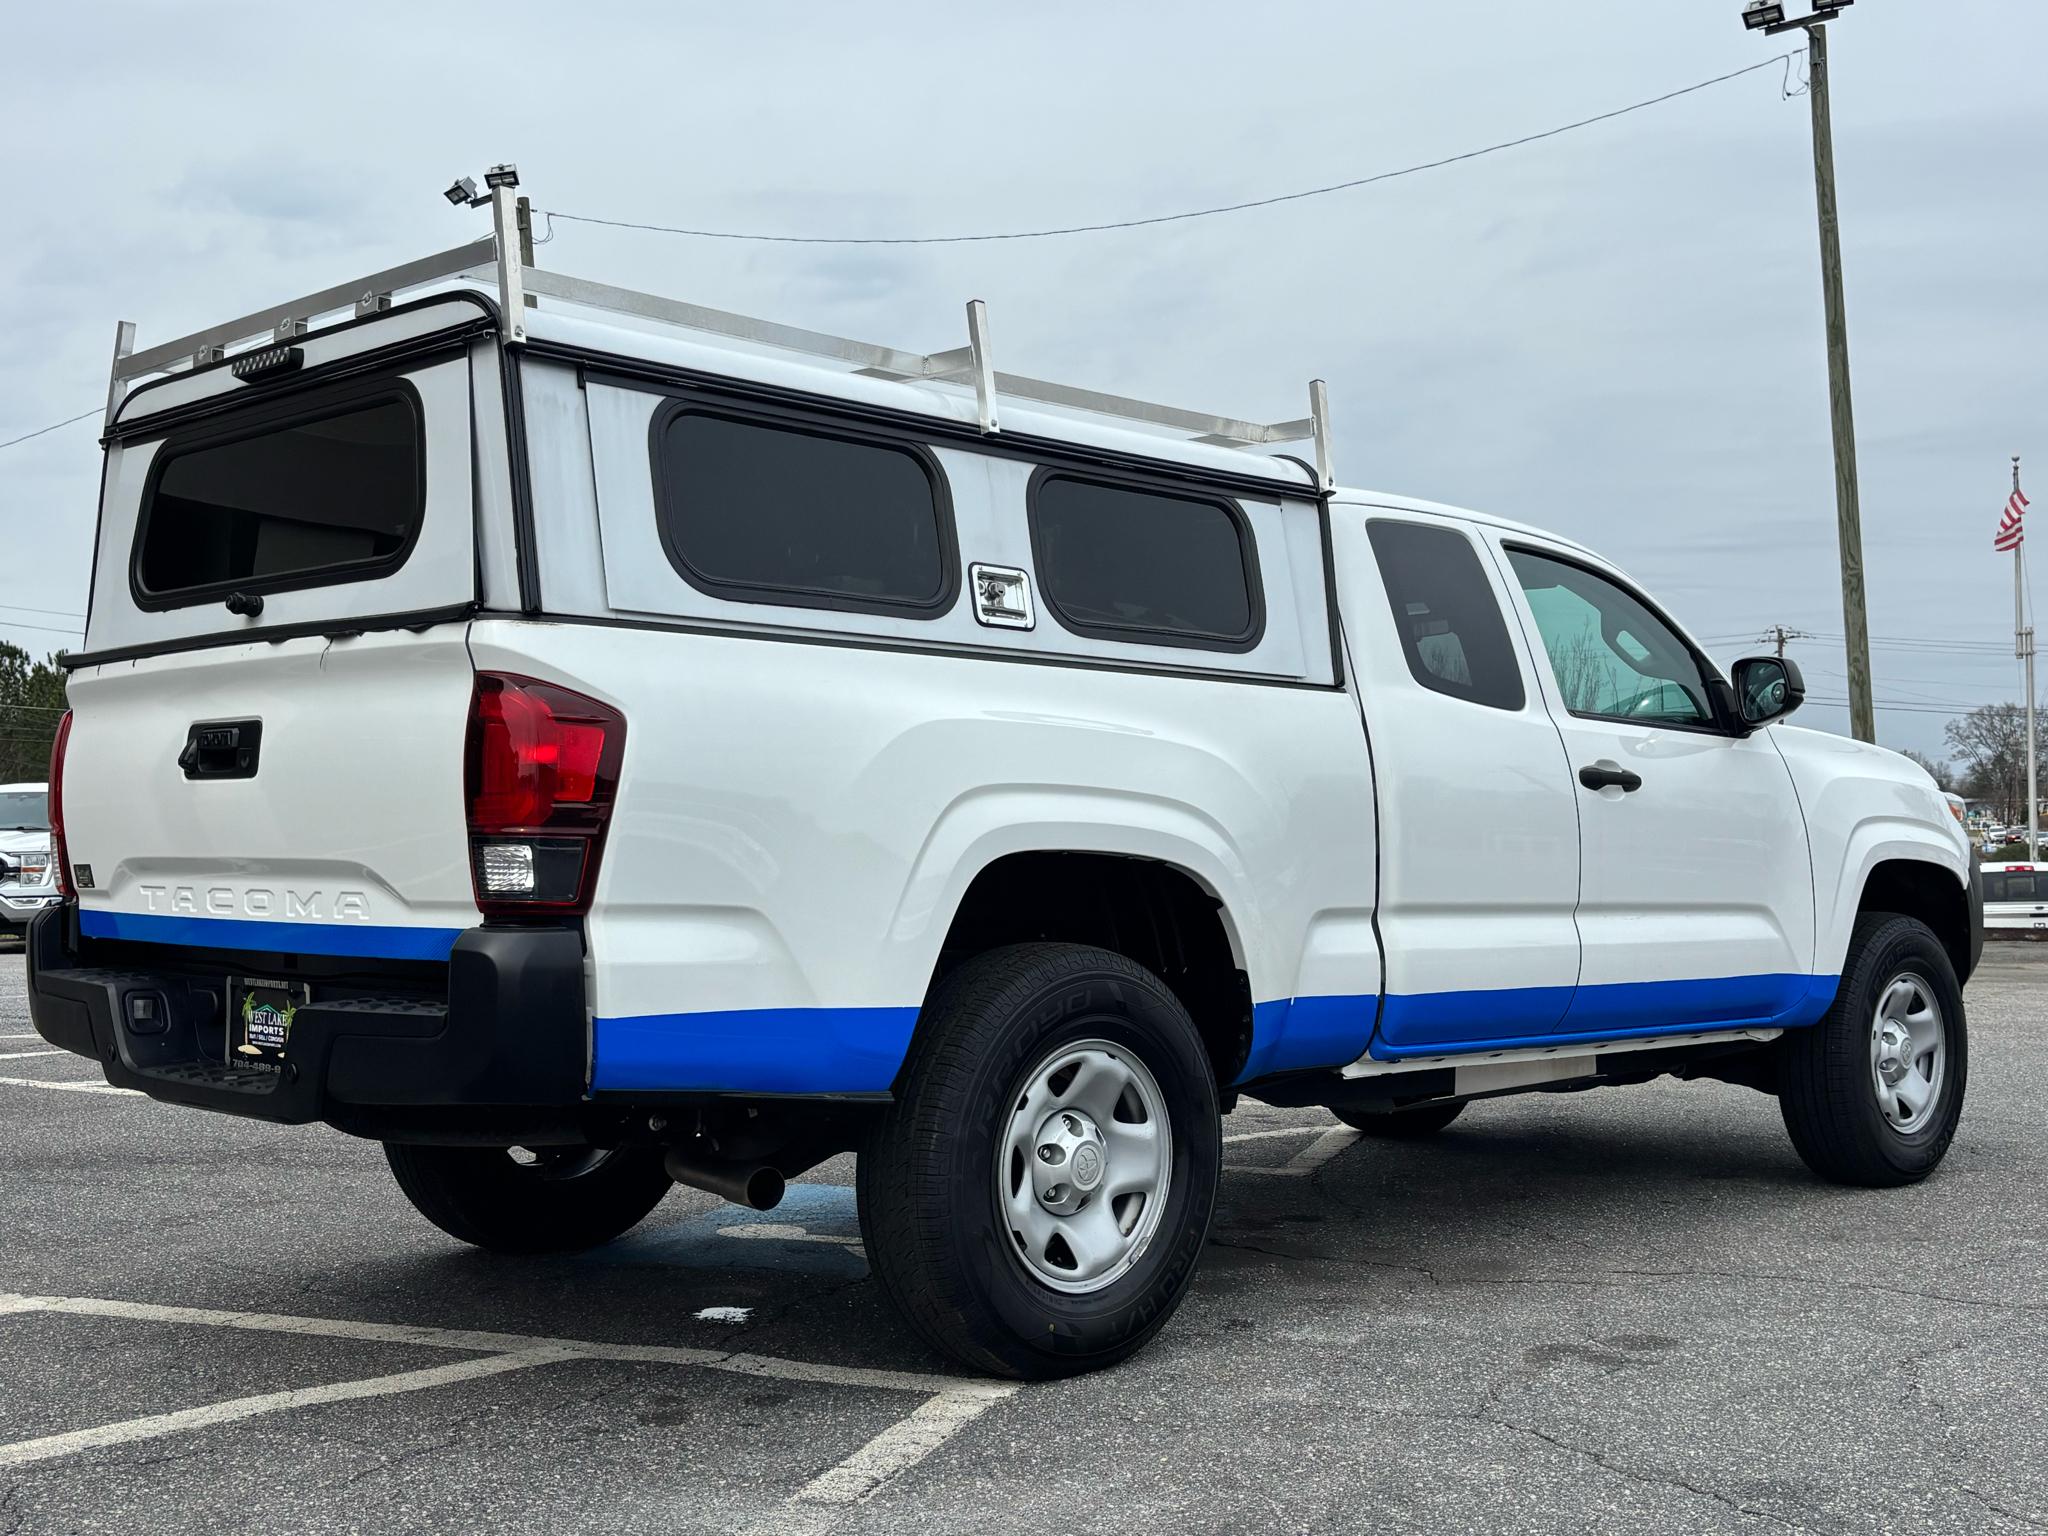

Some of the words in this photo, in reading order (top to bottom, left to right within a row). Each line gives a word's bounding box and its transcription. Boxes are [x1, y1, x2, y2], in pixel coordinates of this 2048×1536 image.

[139, 885, 370, 920] TACOMA
[248, 1010, 267, 1024] WEST
[268, 1012, 288, 1027] LAKE
[249, 1024, 284, 1036] IMPORTS
